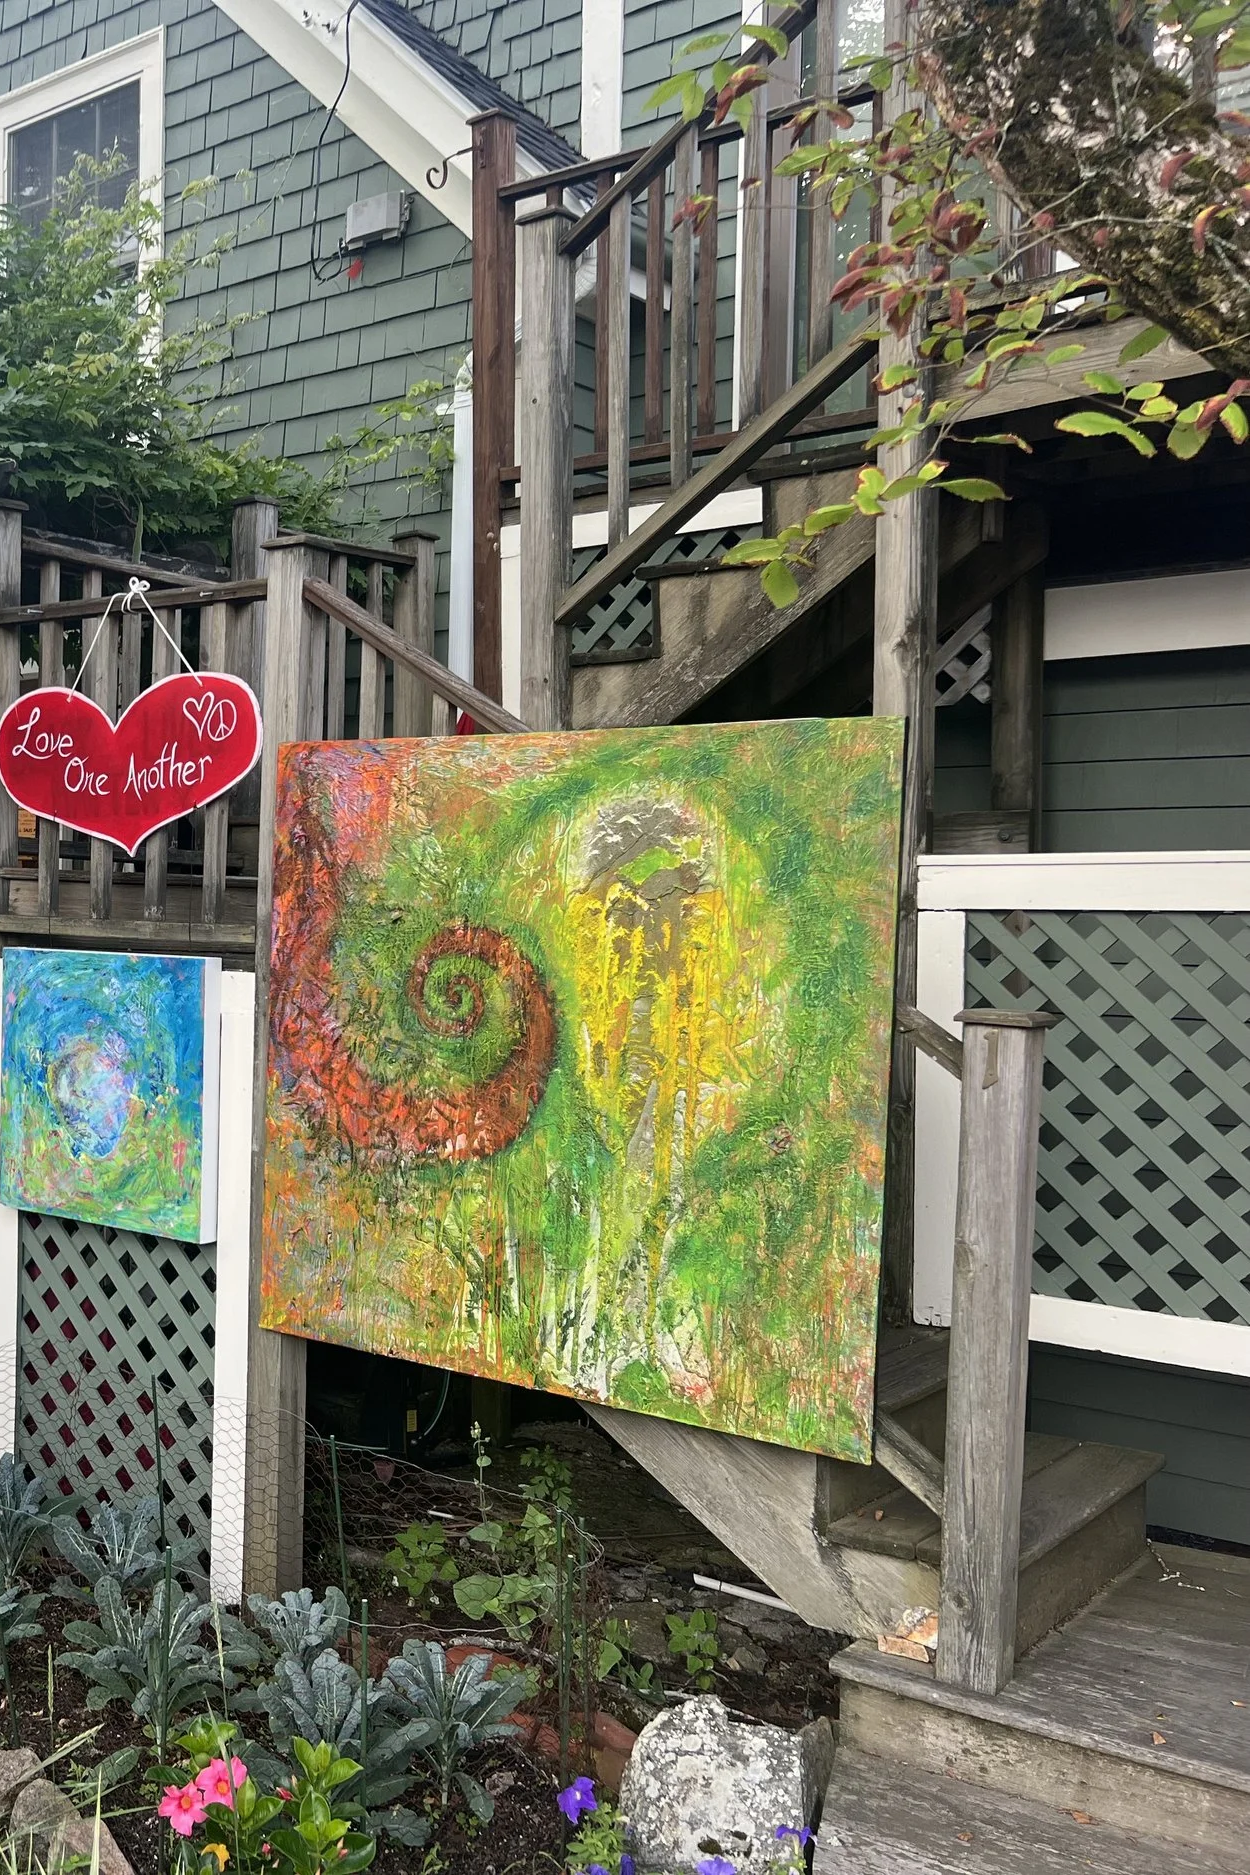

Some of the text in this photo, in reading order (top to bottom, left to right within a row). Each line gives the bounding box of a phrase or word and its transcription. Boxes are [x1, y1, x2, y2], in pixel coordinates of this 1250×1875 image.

[12, 707, 73, 760] Love
[64, 742, 212, 801] One Another
